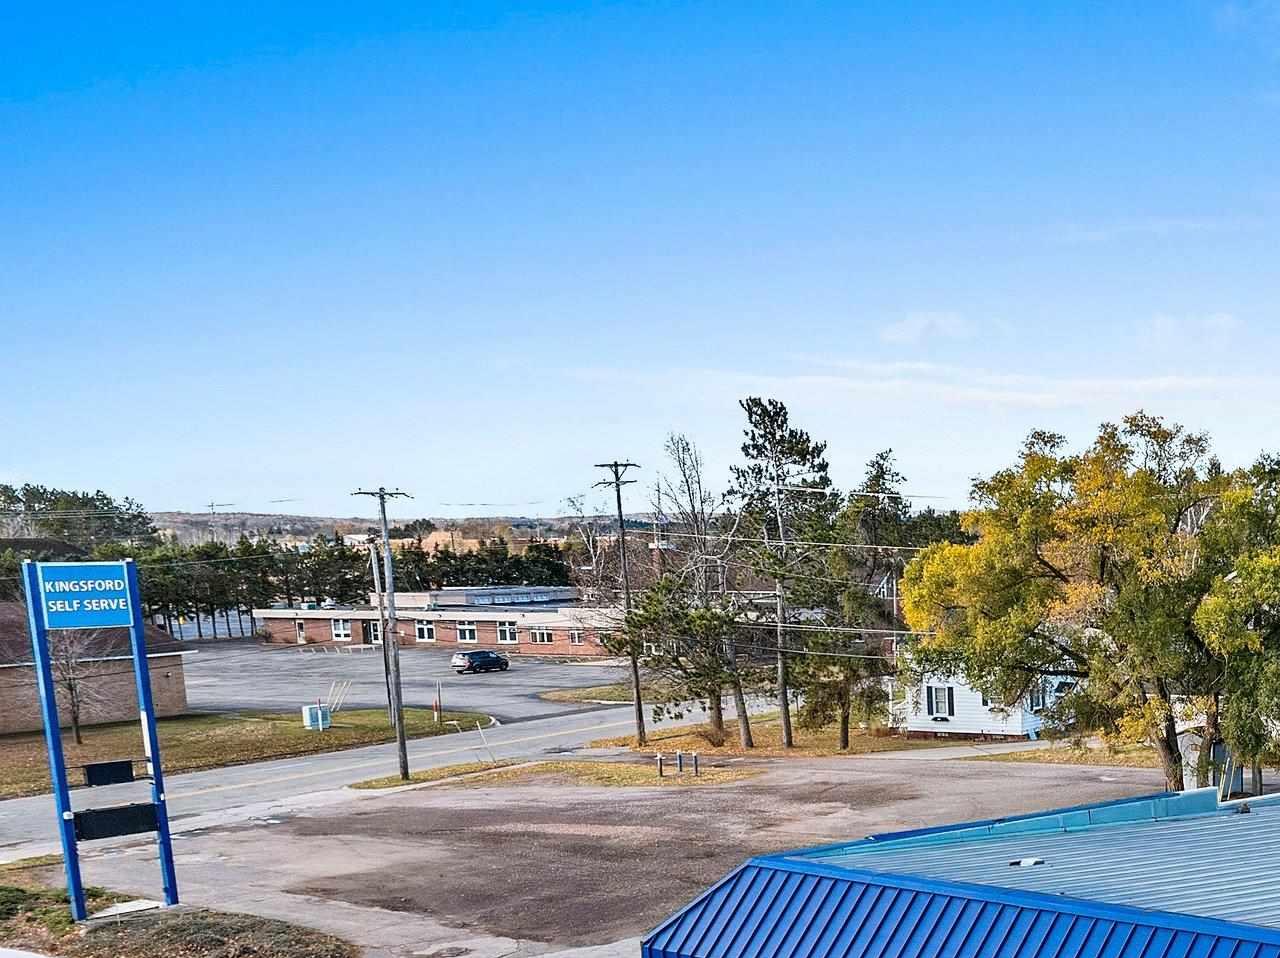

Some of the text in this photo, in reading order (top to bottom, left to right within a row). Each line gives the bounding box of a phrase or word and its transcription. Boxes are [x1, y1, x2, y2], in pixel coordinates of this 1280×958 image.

[45, 579, 125, 593] KINGSFORD
[48, 598, 128, 612] SELF SERVE
